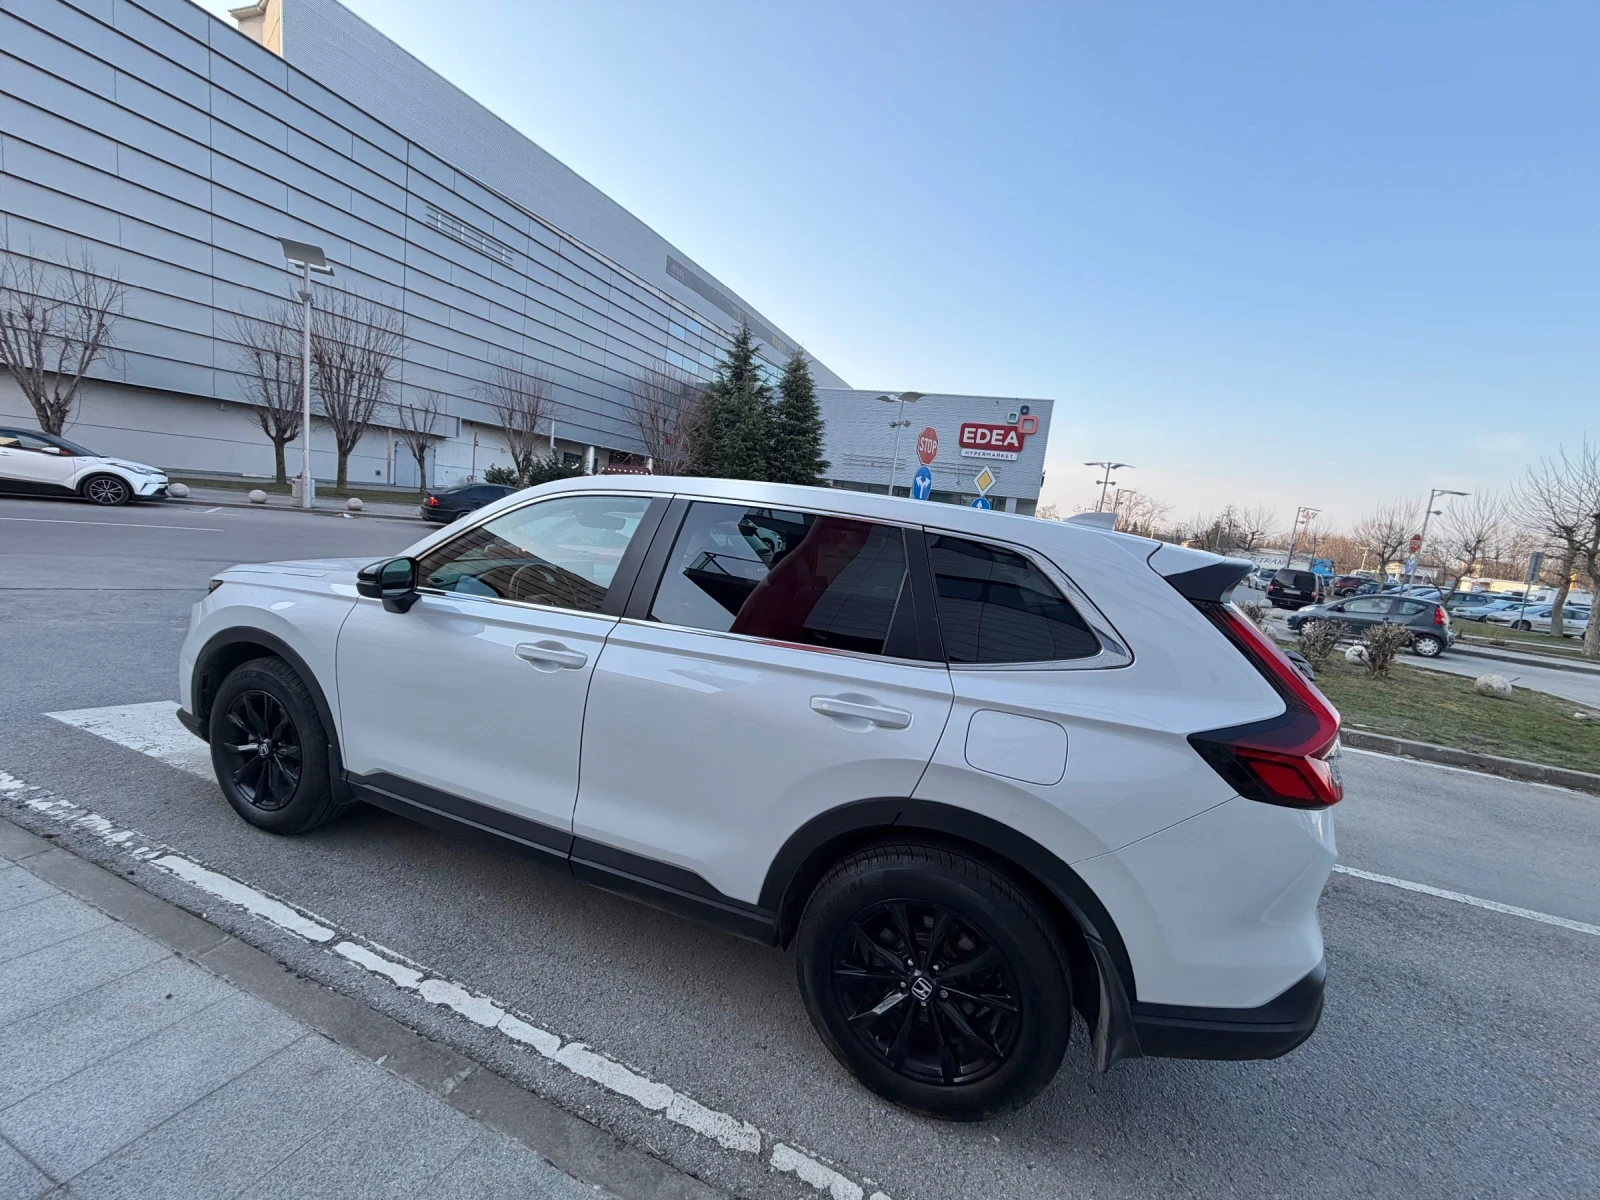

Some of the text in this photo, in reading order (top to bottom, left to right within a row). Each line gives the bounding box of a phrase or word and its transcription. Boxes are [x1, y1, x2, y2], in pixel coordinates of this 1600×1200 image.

[919, 436, 938, 455] STOP
[962, 427, 1019, 447] EDEA
[964, 450, 1014, 459] HYPERMARKET
